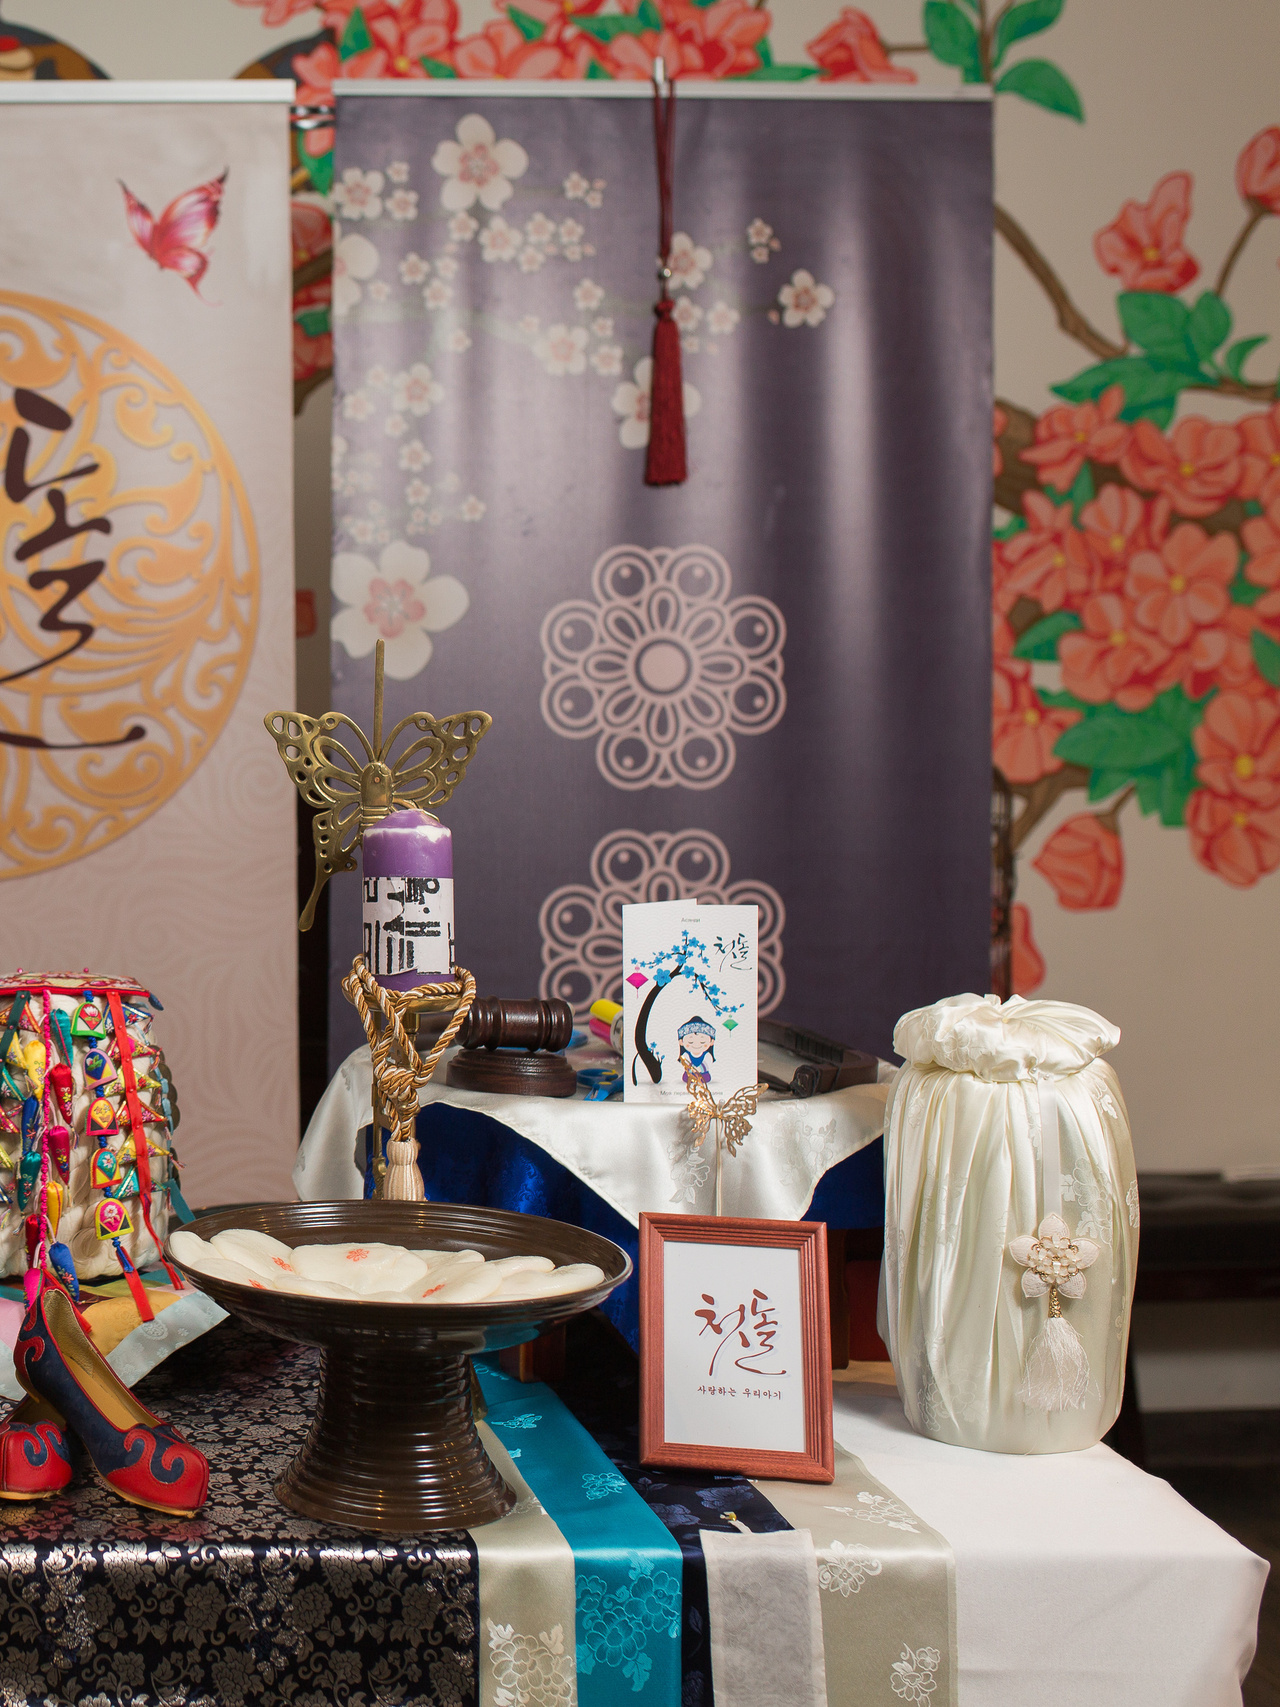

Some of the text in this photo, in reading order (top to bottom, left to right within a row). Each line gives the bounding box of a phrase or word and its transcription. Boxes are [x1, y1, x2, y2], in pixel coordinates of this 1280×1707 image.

[694, 1288, 787, 1376] 첫돌
[697, 1384, 783, 1401] 사랑하는 우리아기
